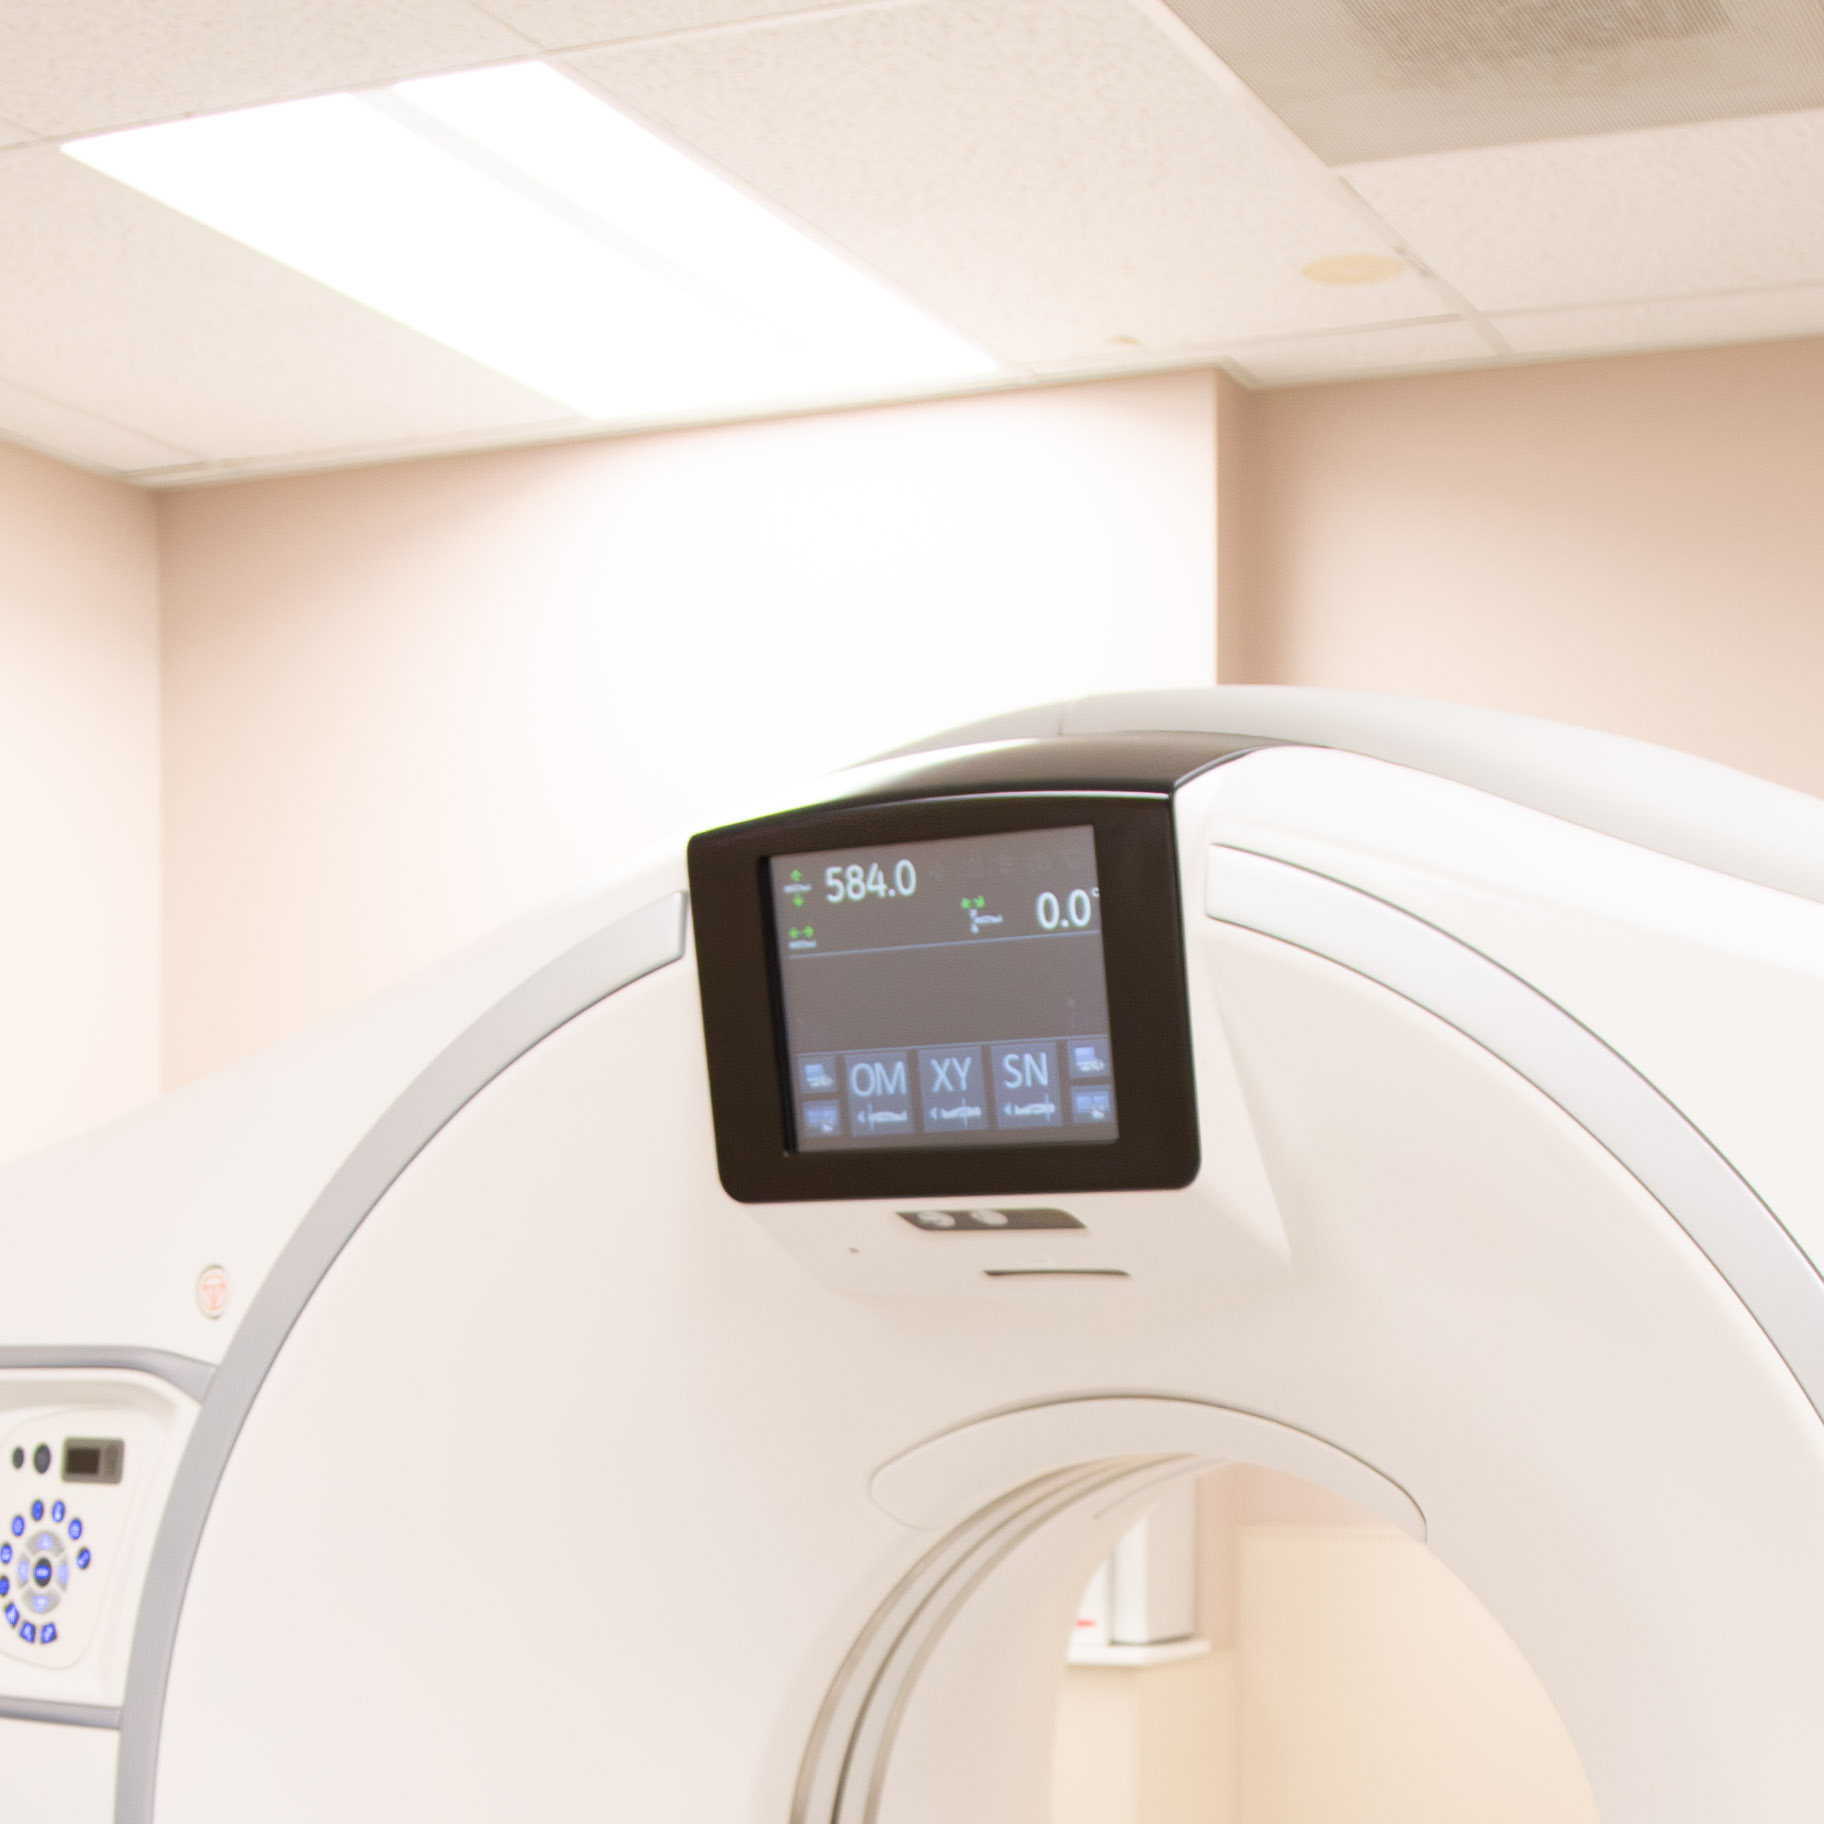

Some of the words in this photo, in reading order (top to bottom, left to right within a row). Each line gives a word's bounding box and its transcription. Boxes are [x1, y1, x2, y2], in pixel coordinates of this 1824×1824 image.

[825, 859, 917, 904] 584.0
[850, 1061, 907, 1097] OM
[930, 1056, 973, 1093] XY
[1003, 1051, 1049, 1089] SN
